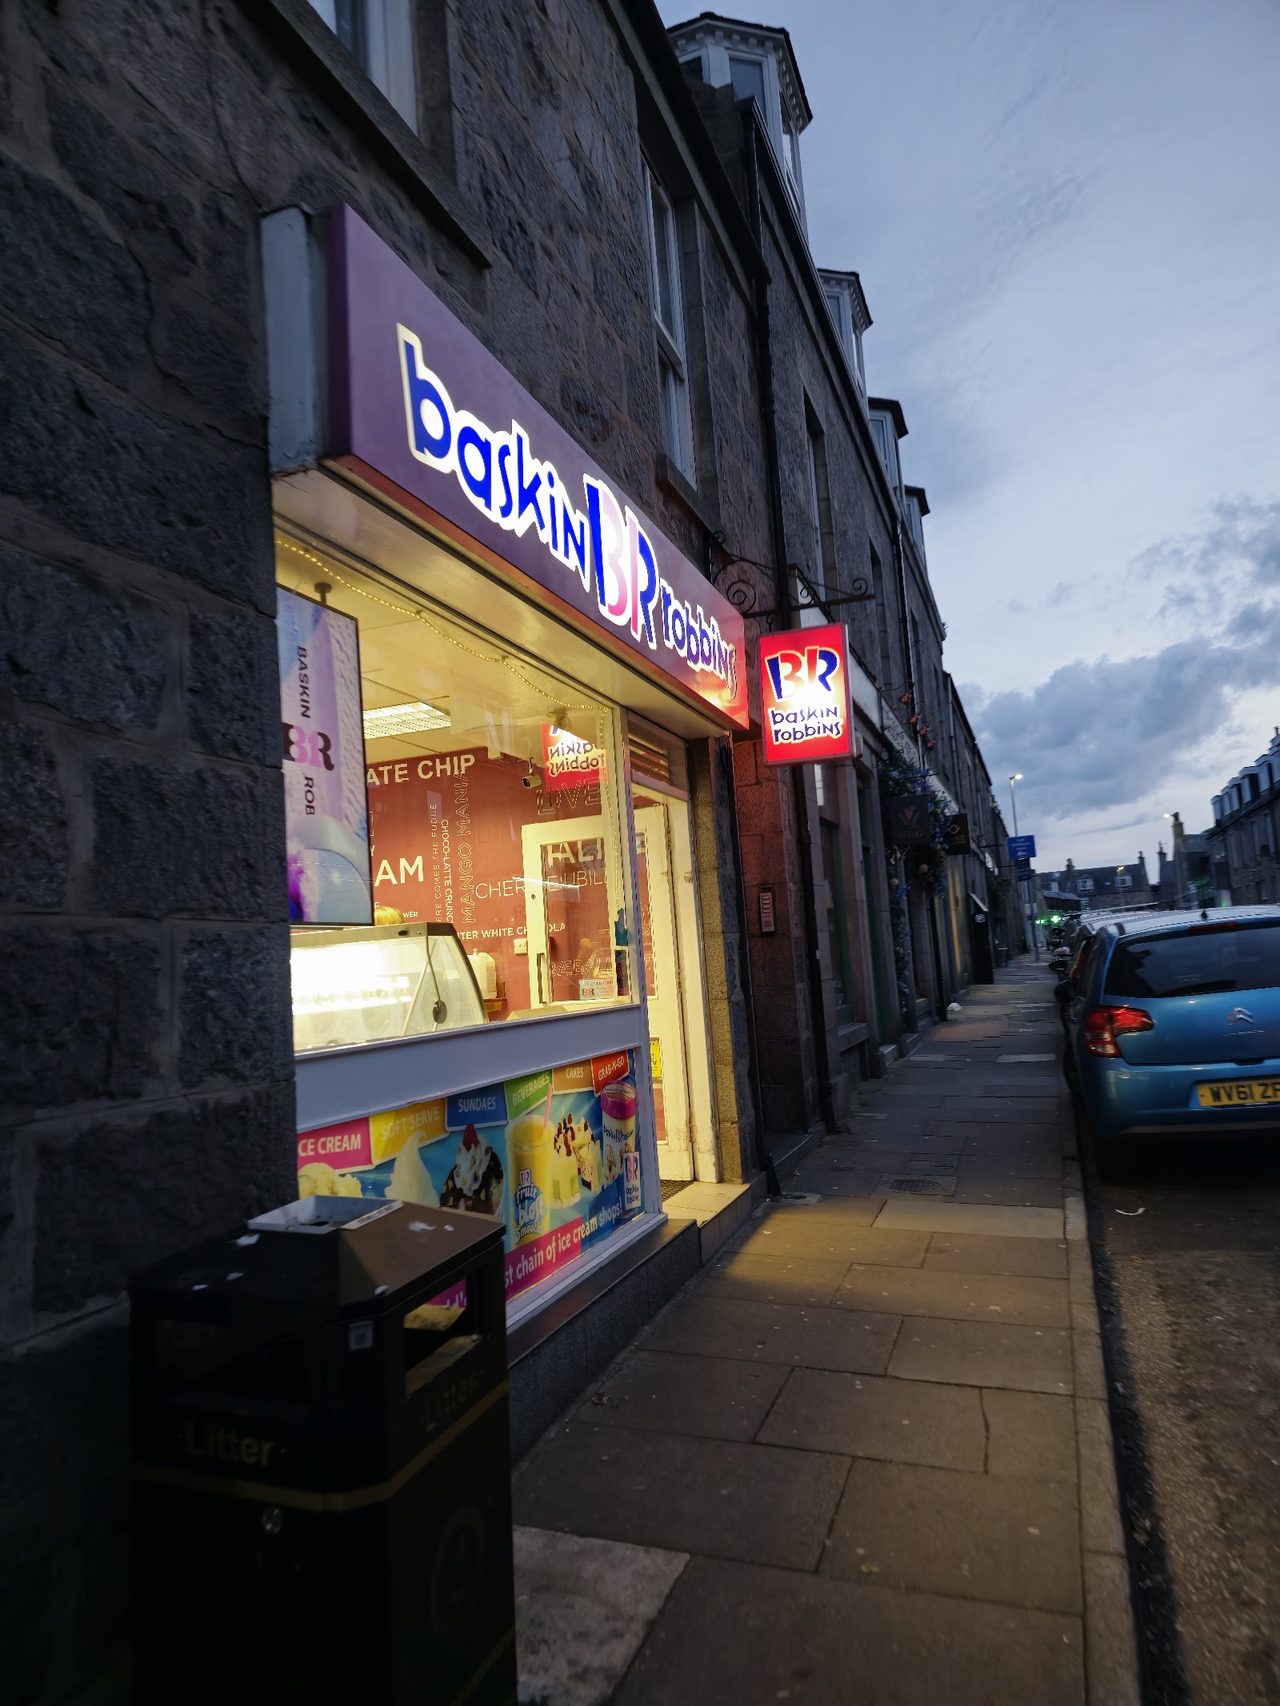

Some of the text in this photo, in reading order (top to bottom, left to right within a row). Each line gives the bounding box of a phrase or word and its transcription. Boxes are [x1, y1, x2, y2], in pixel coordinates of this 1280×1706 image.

[585, 478, 657, 646] BR
[297, 645, 311, 719] BASKIN
[766, 648, 839, 700] BR
[281, 722, 335, 771] BR
[417, 754, 476, 780] CHIP
[303, 776, 316, 816] ROB
[429, 803, 438, 838] FUDGE
[453, 769, 475, 923] MANGO MANIA
[481, 927, 515, 939] WHITE
[511, 1073, 550, 1106] BEVERAGES
[566, 1066, 584, 1079] CAKES
[458, 1096, 497, 1113] SUNDAES
[380, 1106, 440, 1141] SOFT SERVE
[317, 1134, 361, 1153] CREAM
[516, 1251, 544, 1280] chain
[546, 1235, 557, 1263] of
[558, 1231, 571, 1253] ice
[572, 1216, 598, 1244] cream
[600, 1196, 622, 1225] shops!
[184, 1423, 275, 1468] Litter
